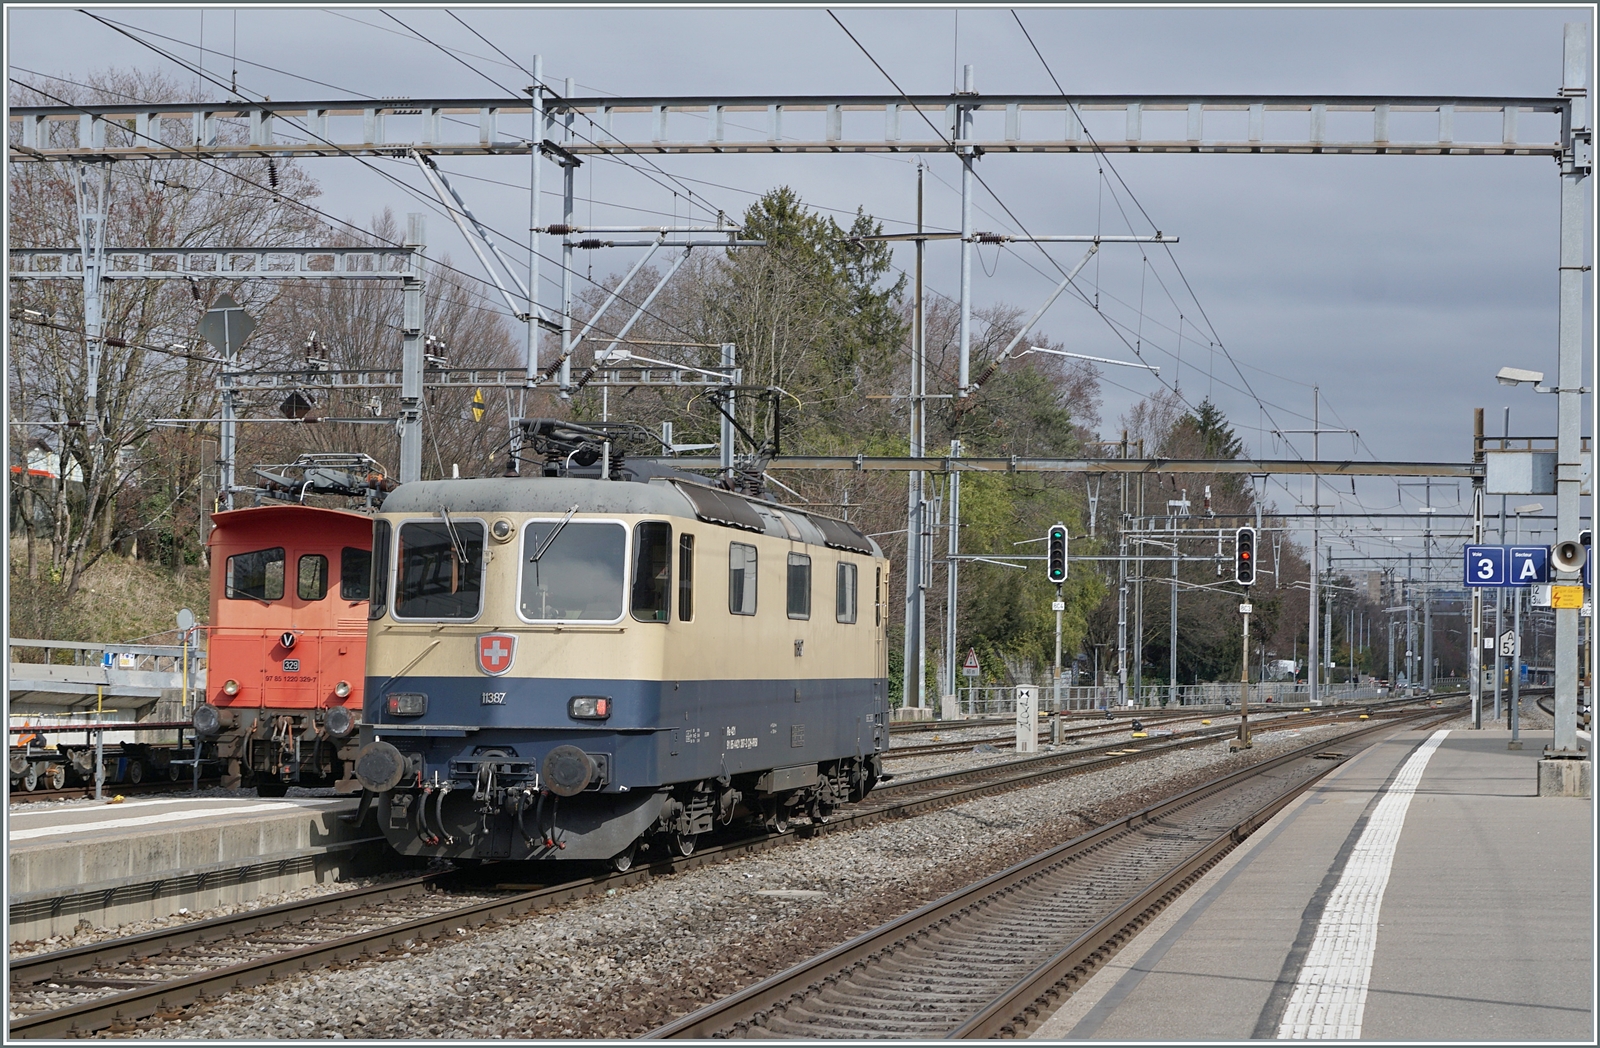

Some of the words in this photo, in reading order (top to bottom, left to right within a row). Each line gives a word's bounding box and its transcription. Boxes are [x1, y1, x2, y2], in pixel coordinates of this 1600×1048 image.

[1477, 558, 1494, 579] 3
[1519, 559, 1538, 580] A
[1531, 584, 1540, 595] 12
[283, 634, 293, 646] V
[284, 661, 298, 670] 329
[482, 691, 506, 704] 11387
